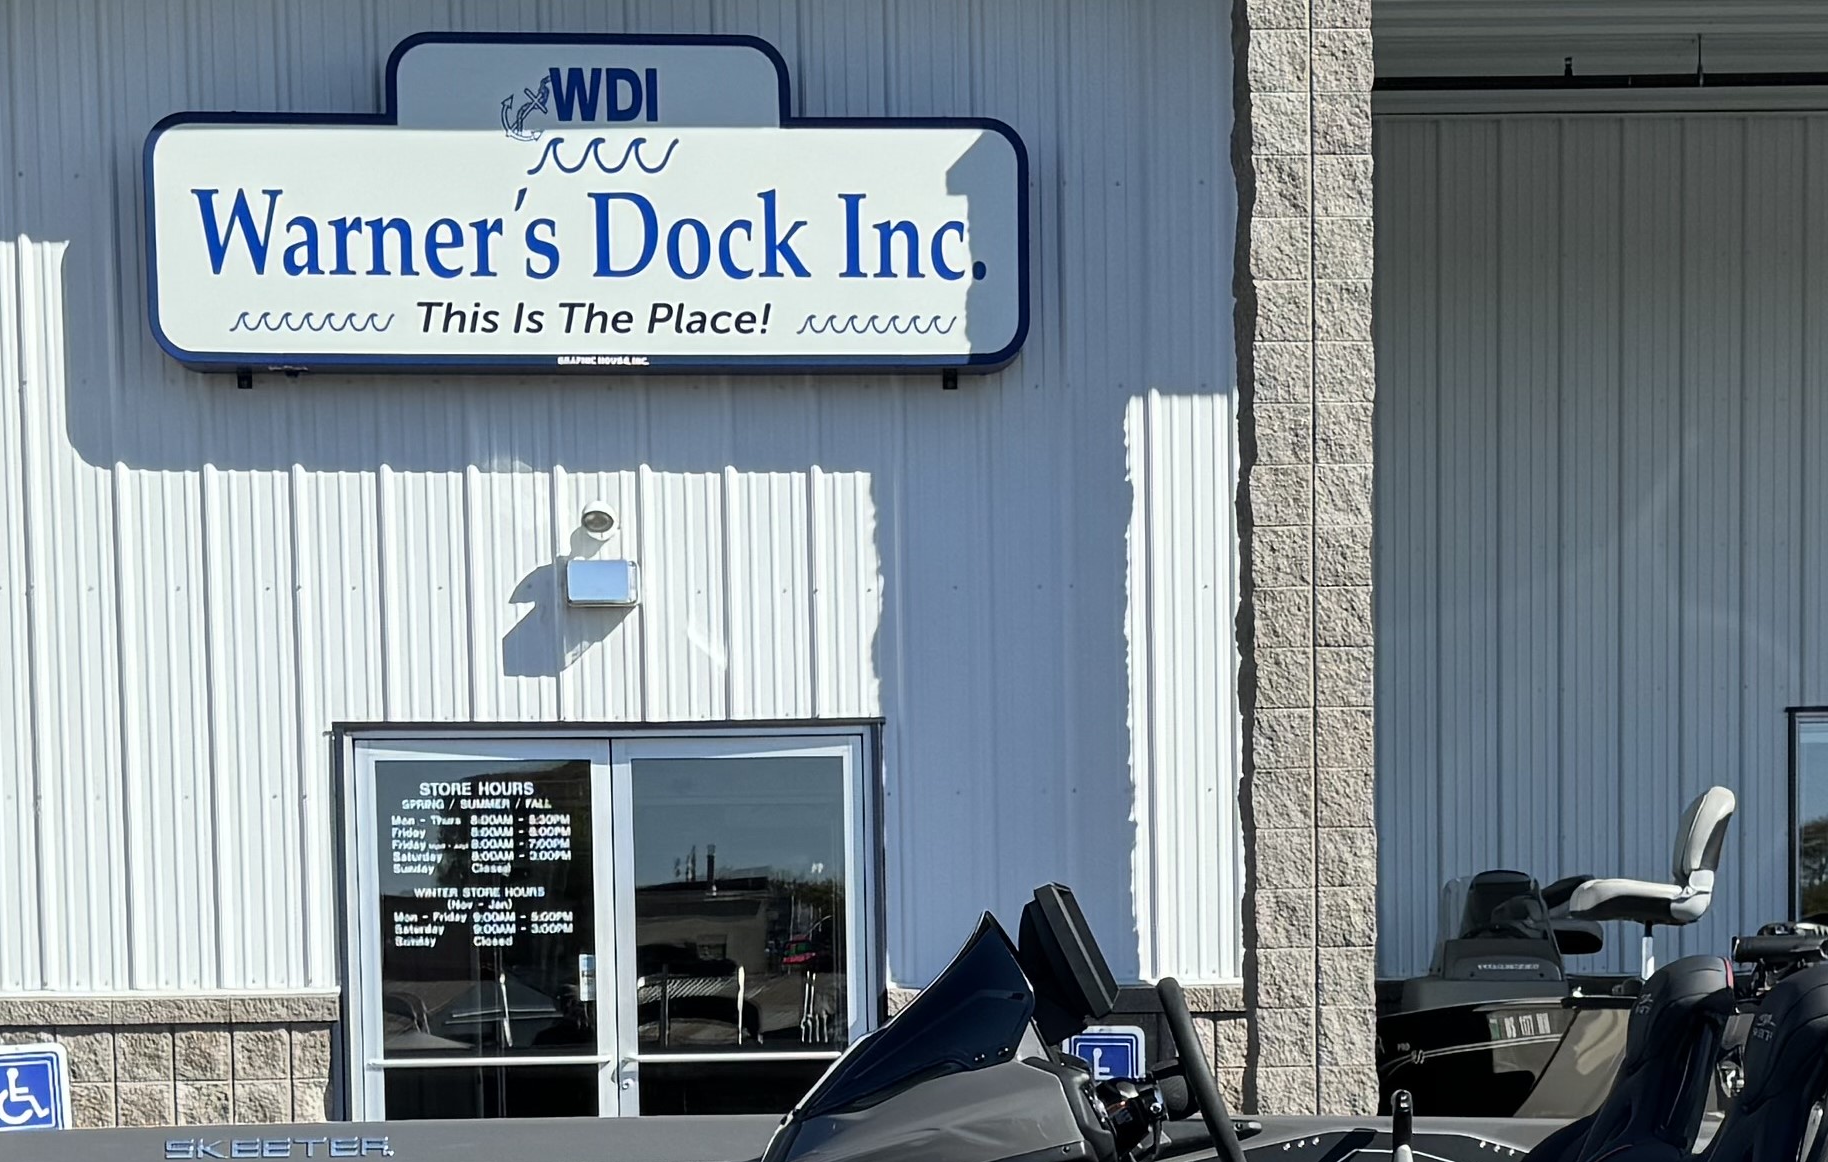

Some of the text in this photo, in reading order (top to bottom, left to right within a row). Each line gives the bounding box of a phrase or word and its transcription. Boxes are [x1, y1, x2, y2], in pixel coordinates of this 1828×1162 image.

[549, 67, 659, 122] WDI
[191, 187, 987, 282] Warner's Dock Inc.
[416, 302, 771, 337] This Is The Place!
[419, 782, 534, 796] STORE HOURS
[402, 799, 444, 810] SPRING
[460, 799, 510, 809] SUMMER
[525, 799, 552, 809] FALL
[391, 816, 415, 826] Mon
[430, 816, 461, 825] Thurs
[391, 827, 426, 839] Friday
[392, 839, 427, 851] Friday
[393, 851, 442, 863] Saturday
[393, 863, 511, 875] Sunday Closed
[414, 887, 545, 898] WINTER STORE HOURS
[394, 912, 417, 922] Mon
[433, 911, 467, 923] Friday
[394, 924, 445, 935] Saturday
[395, 936, 513, 947] Sunday Closed
[164, 1137, 390, 1160] SKEETER
